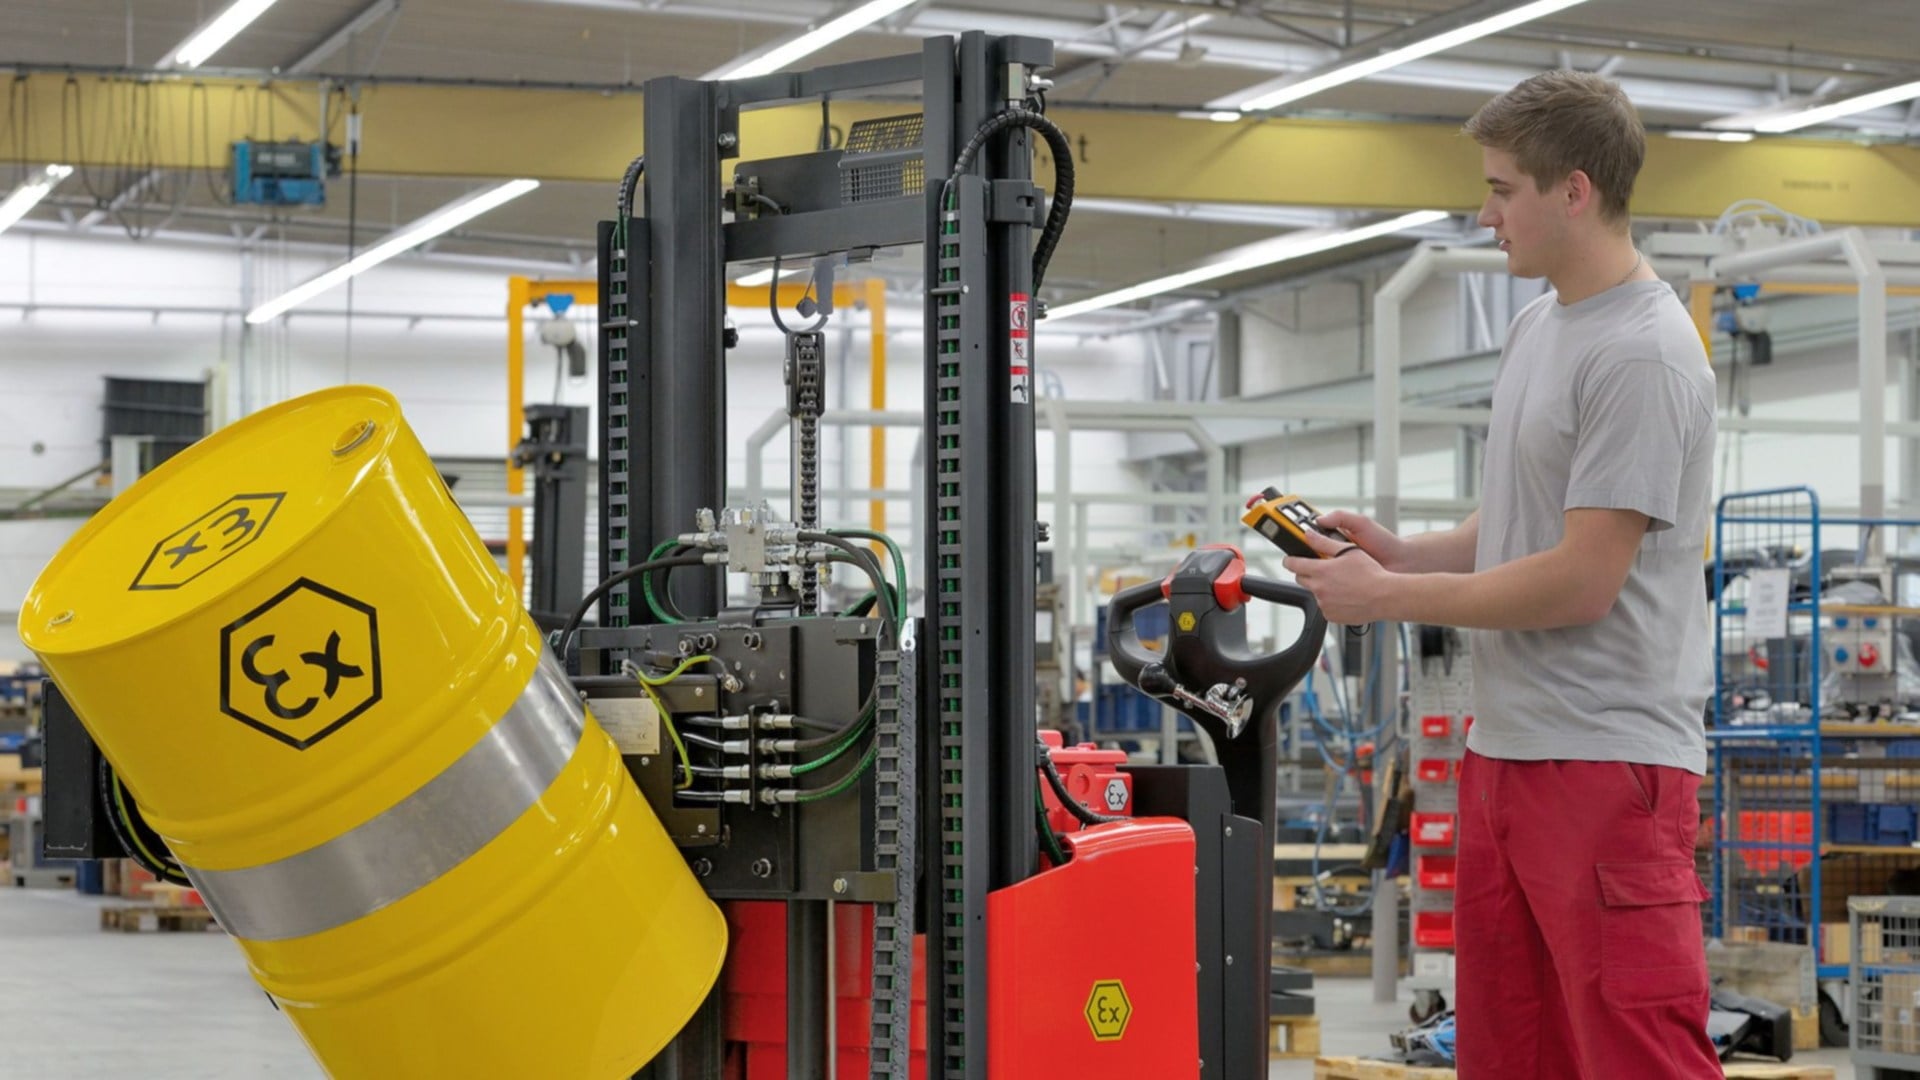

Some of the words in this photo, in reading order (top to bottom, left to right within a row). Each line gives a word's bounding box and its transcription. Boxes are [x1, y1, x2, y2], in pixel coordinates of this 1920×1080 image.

[241, 630, 365, 719] Ex
[1108, 783, 1124, 805] Ex
[1097, 995, 1120, 1024] Ex
